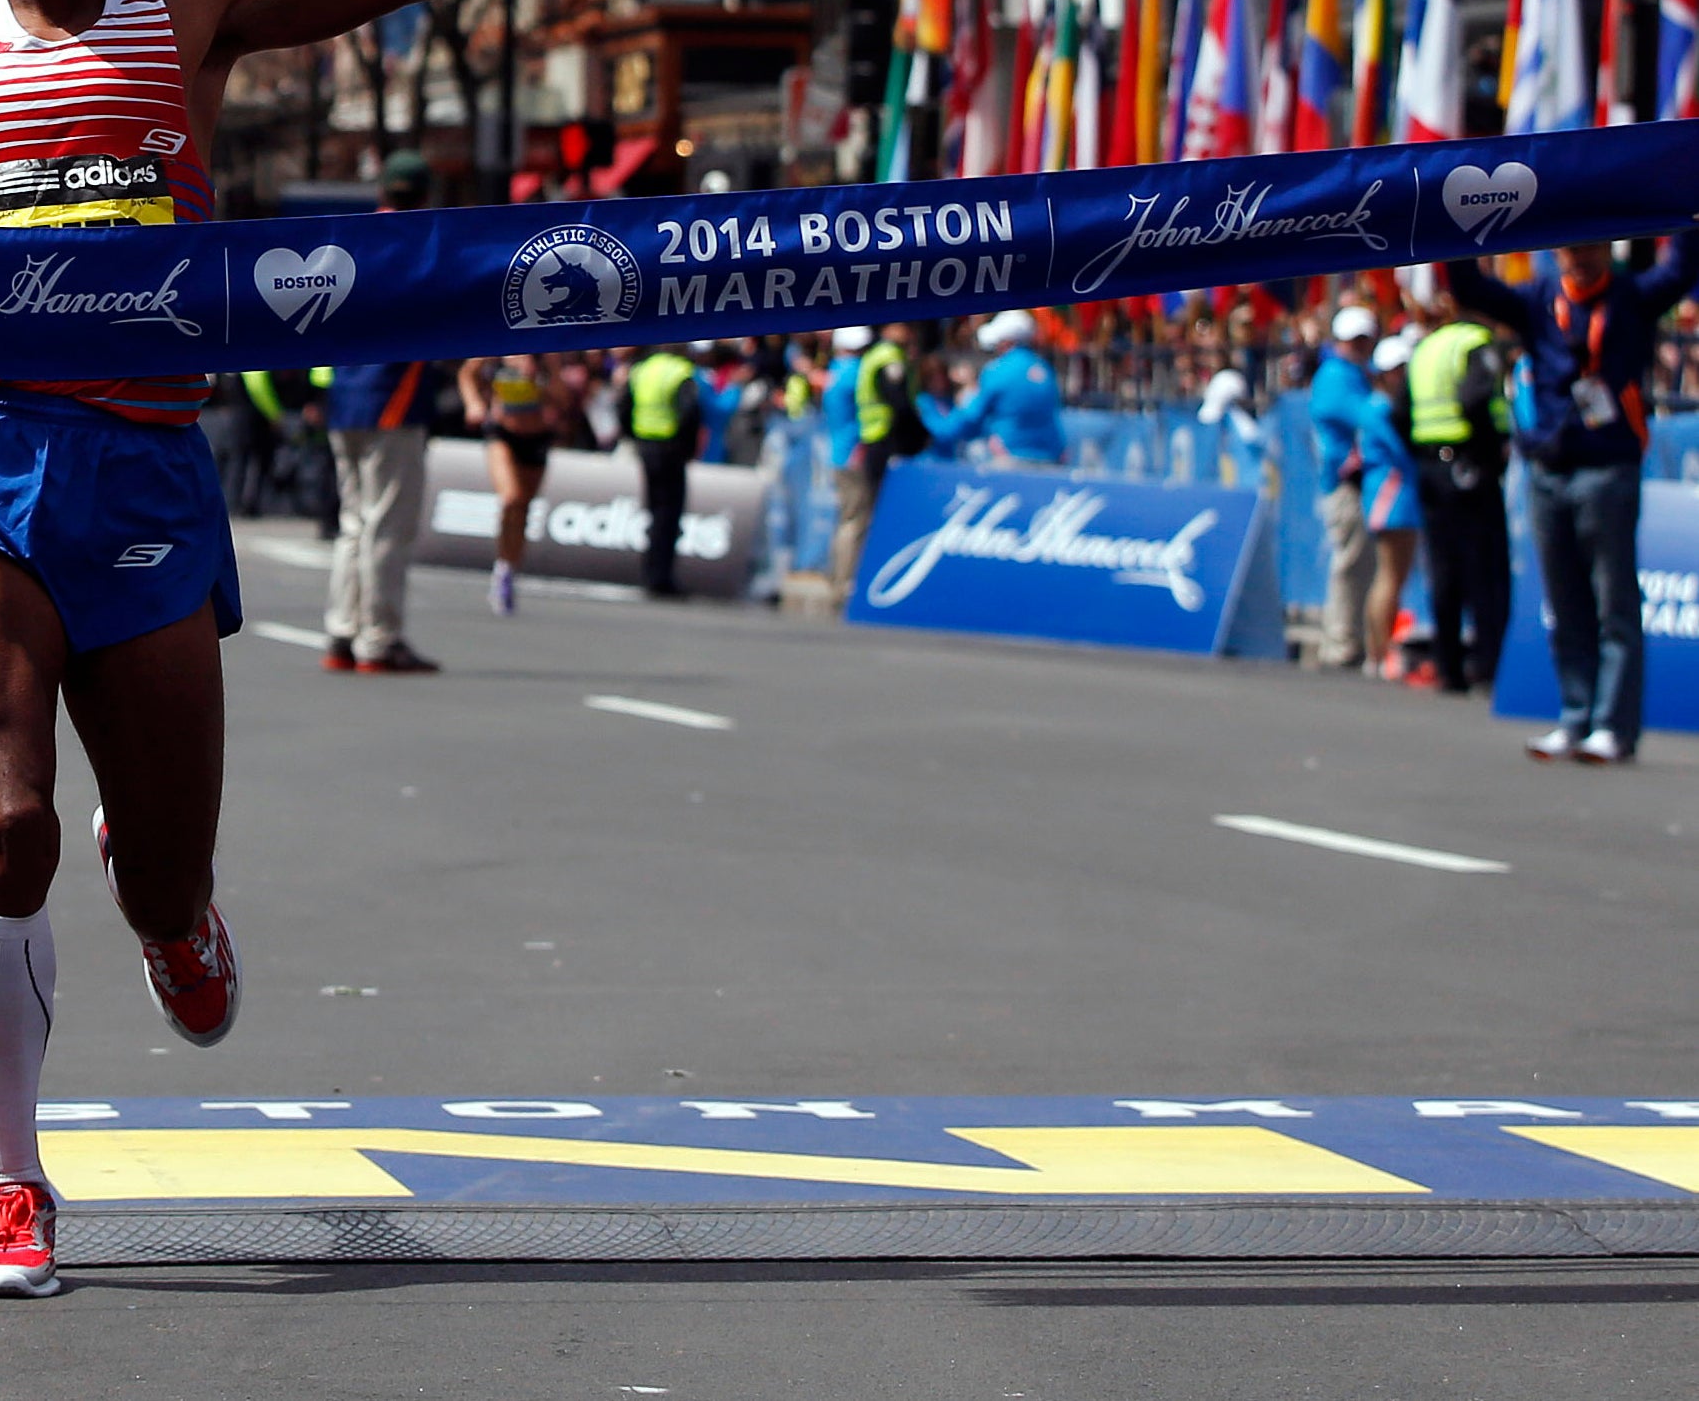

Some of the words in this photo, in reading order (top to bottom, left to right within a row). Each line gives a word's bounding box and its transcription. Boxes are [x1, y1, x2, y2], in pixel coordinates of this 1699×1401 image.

[1459, 190, 1519, 207] BOSTON
[657, 215, 777, 264] 2014
[799, 200, 1013, 254] BOSTON
[1072, 192, 1203, 294] John
[1200, 180, 1388, 251] Hancock
[273, 273, 337, 292] BOSTON
[507, 266, 526, 319] BOSTON
[520, 229, 586, 265] ATHLETIC
[587, 232, 637, 313] ASSOCIATION
[657, 254, 1013, 316] MARATHON
